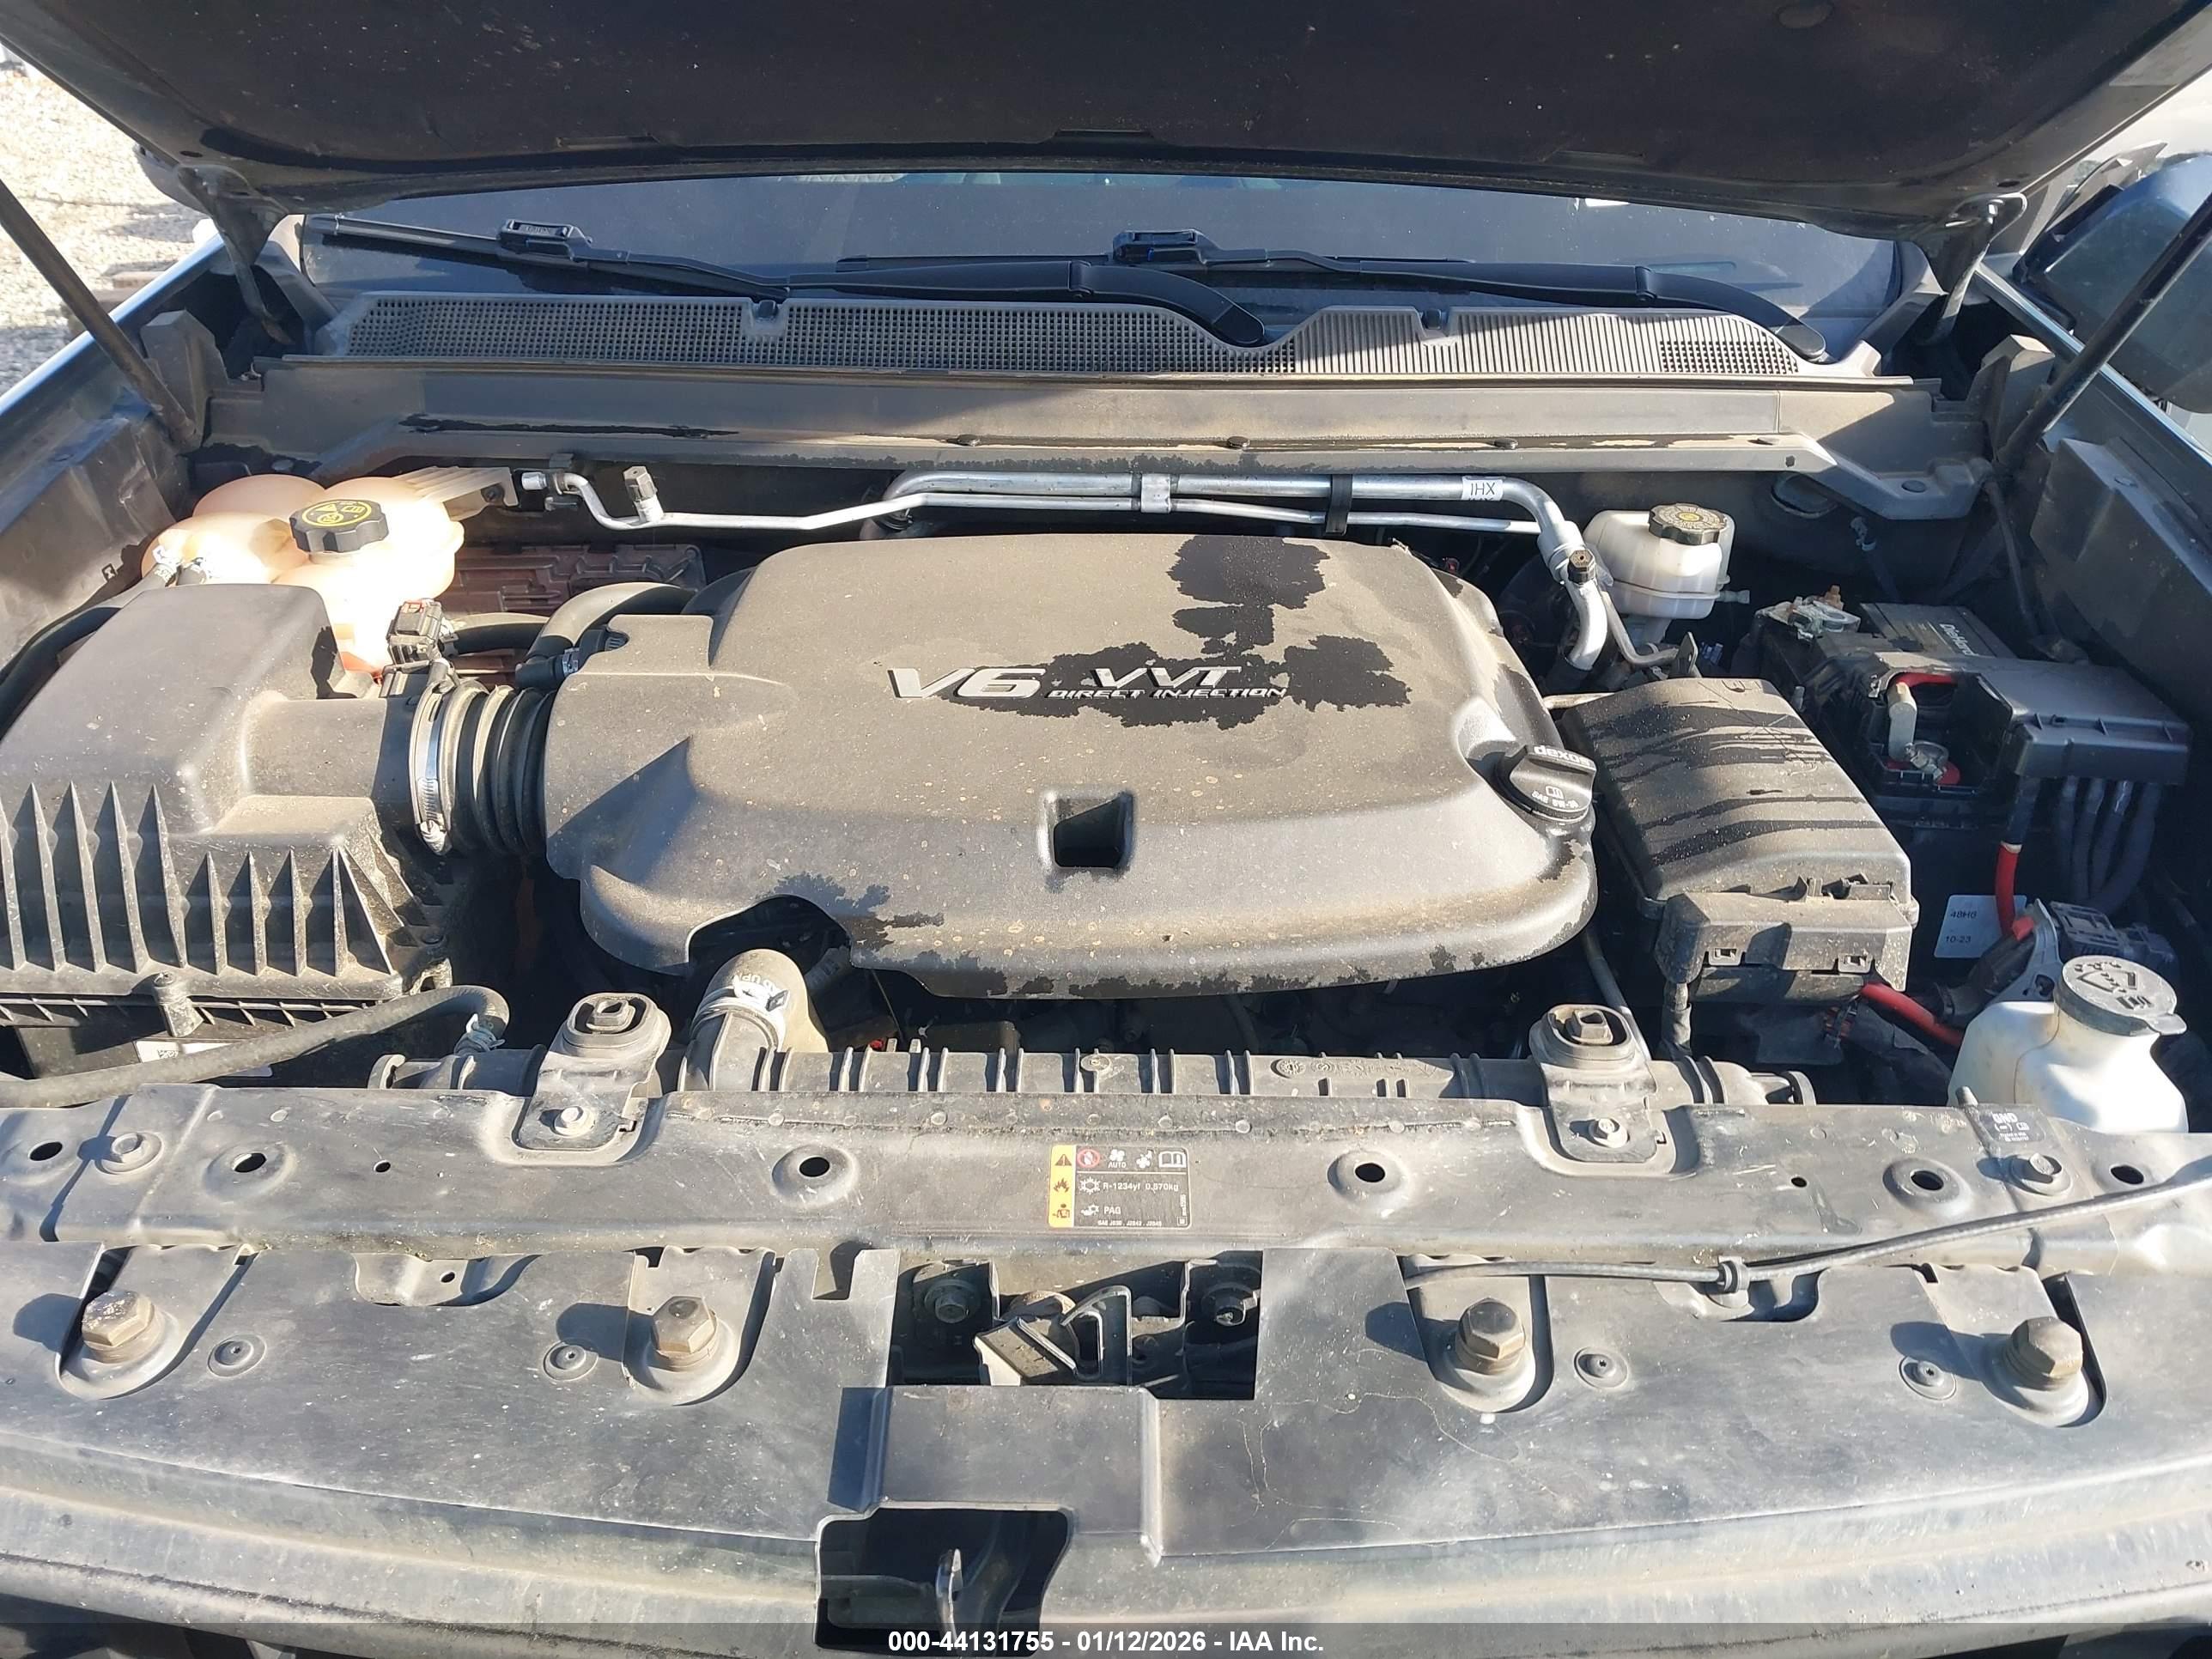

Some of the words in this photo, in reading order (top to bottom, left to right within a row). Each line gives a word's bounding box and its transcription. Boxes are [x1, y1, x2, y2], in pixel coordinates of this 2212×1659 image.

[888, 667, 1047, 699] V6
[1090, 665, 1243, 688] VVT
[1044, 689, 1146, 700] DIRECT
[1149, 688, 1286, 700] INJECTION
[1534, 744, 1591, 767] dexos
[1991, 1112, 2018, 1124] GND
[1103, 1182, 1141, 1192] R-1234yf
[1103, 1206, 1121, 1215] PAG
